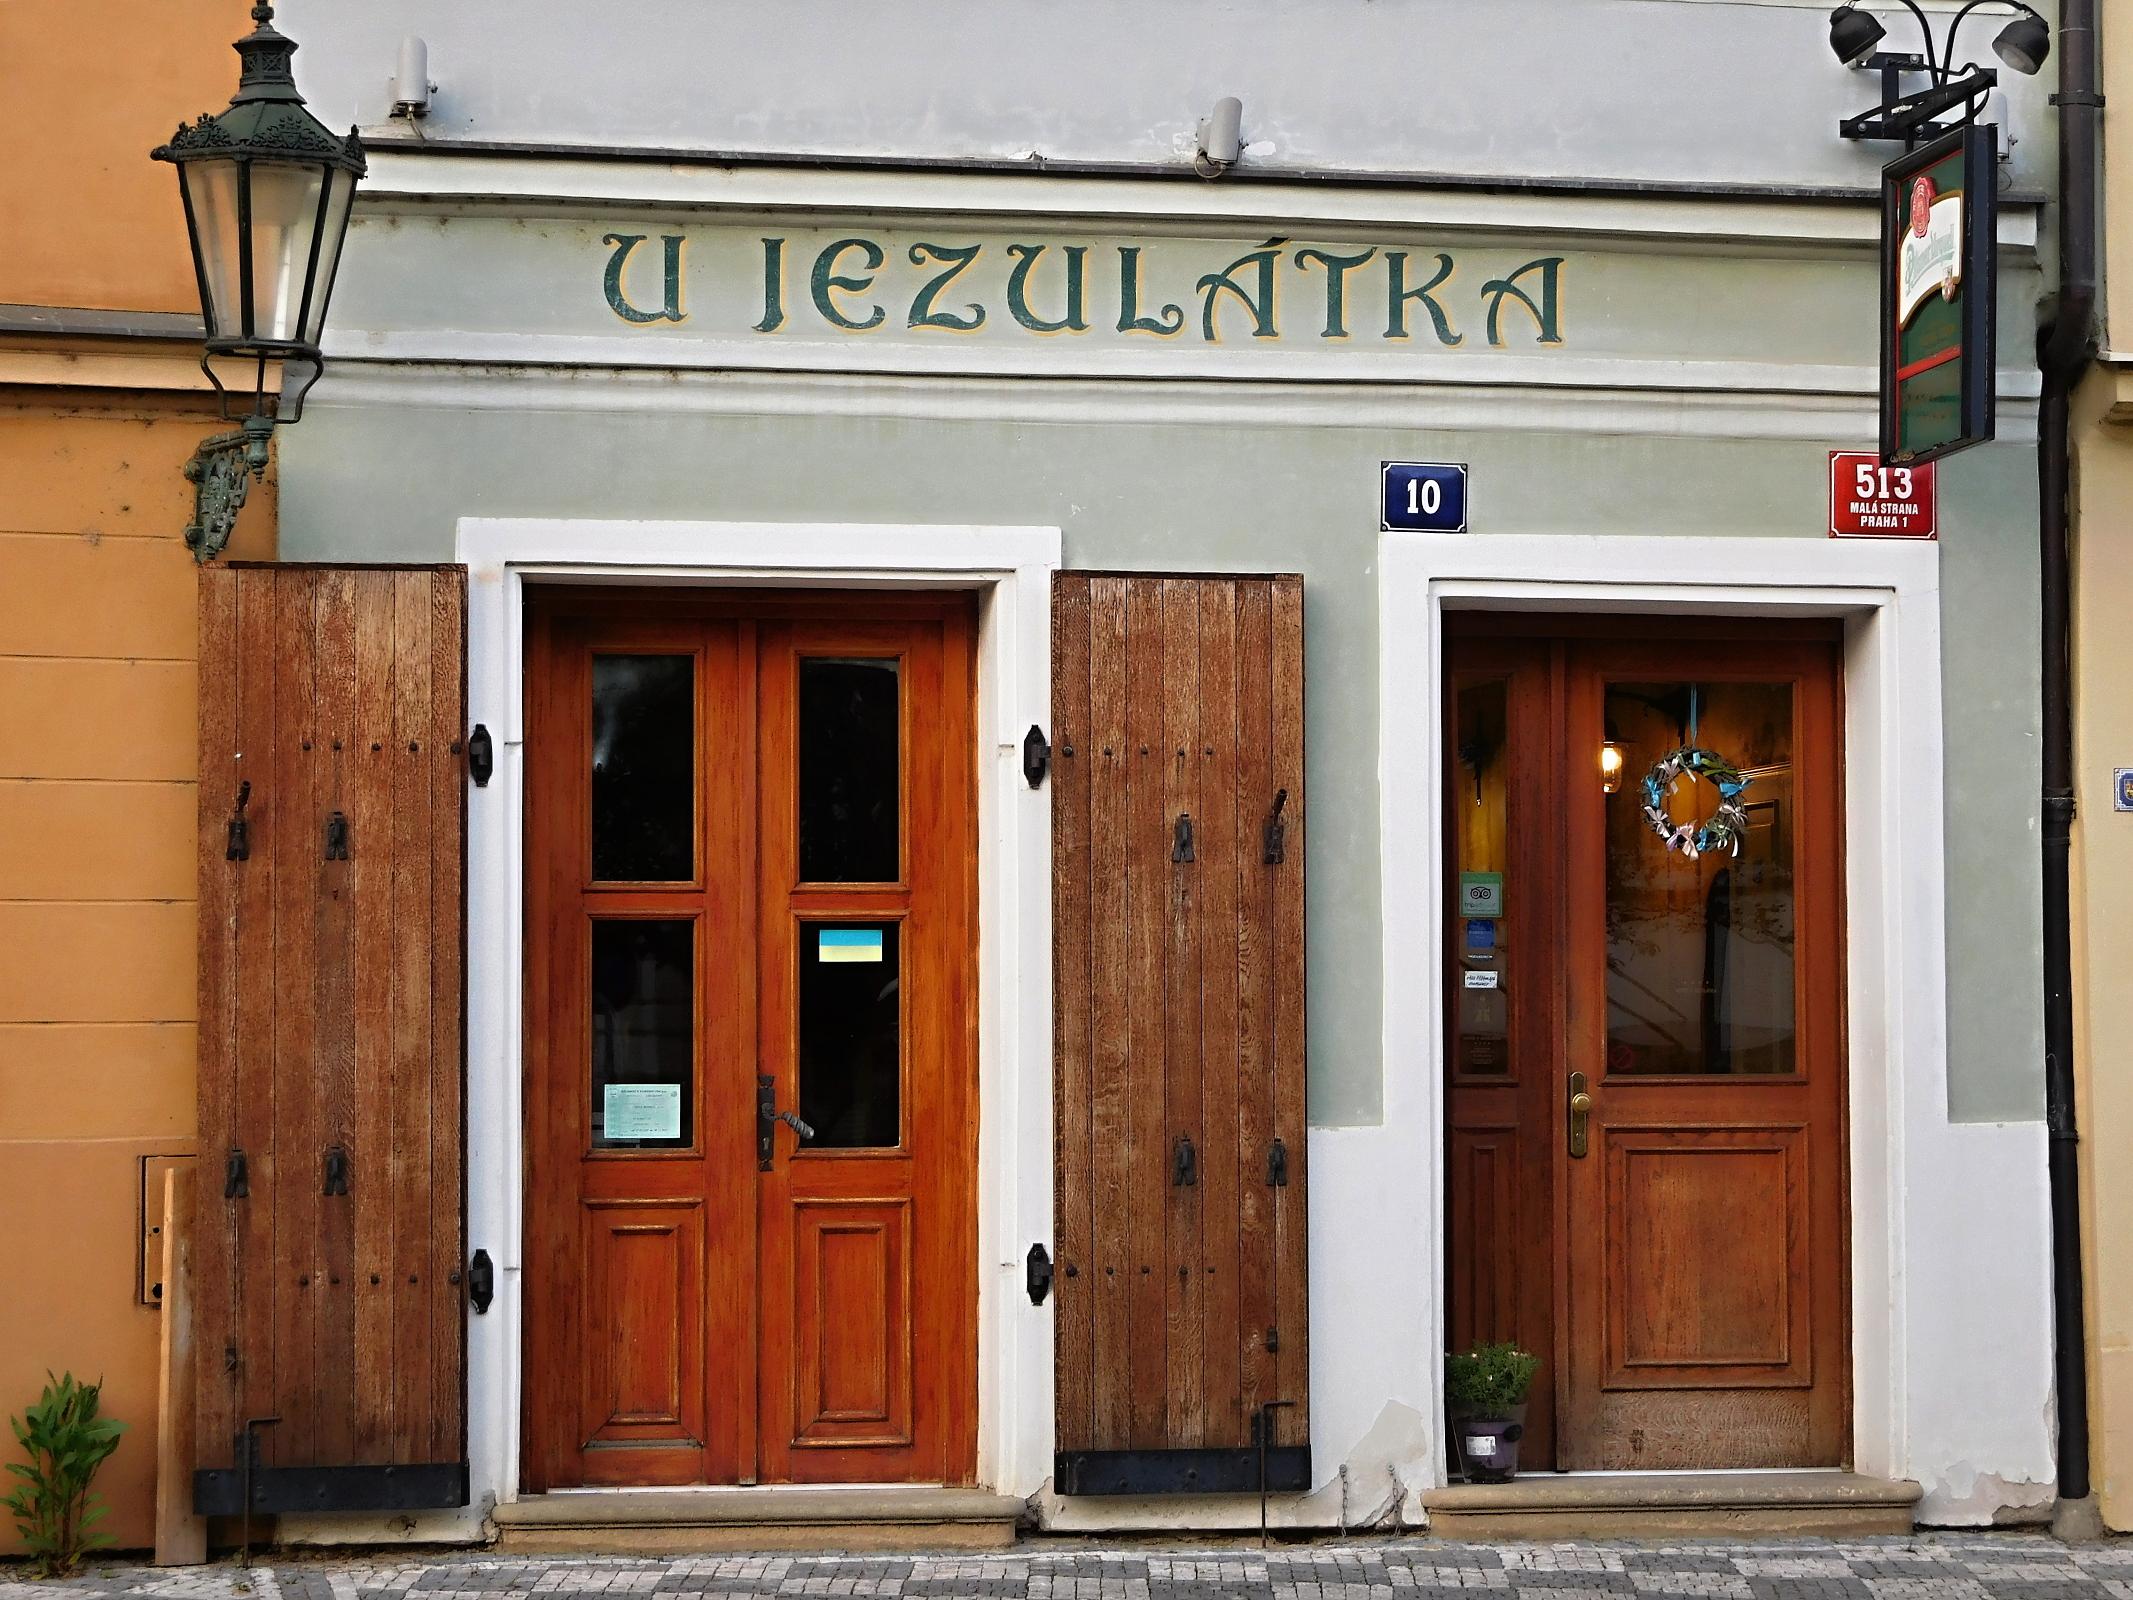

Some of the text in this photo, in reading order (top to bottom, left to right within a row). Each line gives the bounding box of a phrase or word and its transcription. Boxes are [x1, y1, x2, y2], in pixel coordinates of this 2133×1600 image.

[602, 233, 1566, 346] U JEZULÁTKA
[1407, 479, 1441, 514] 10
[1856, 464, 1912, 499] 513
[1850, 499, 1918, 514] MALÁ STRANA
[1860, 515, 1908, 528] PRAHA 1
